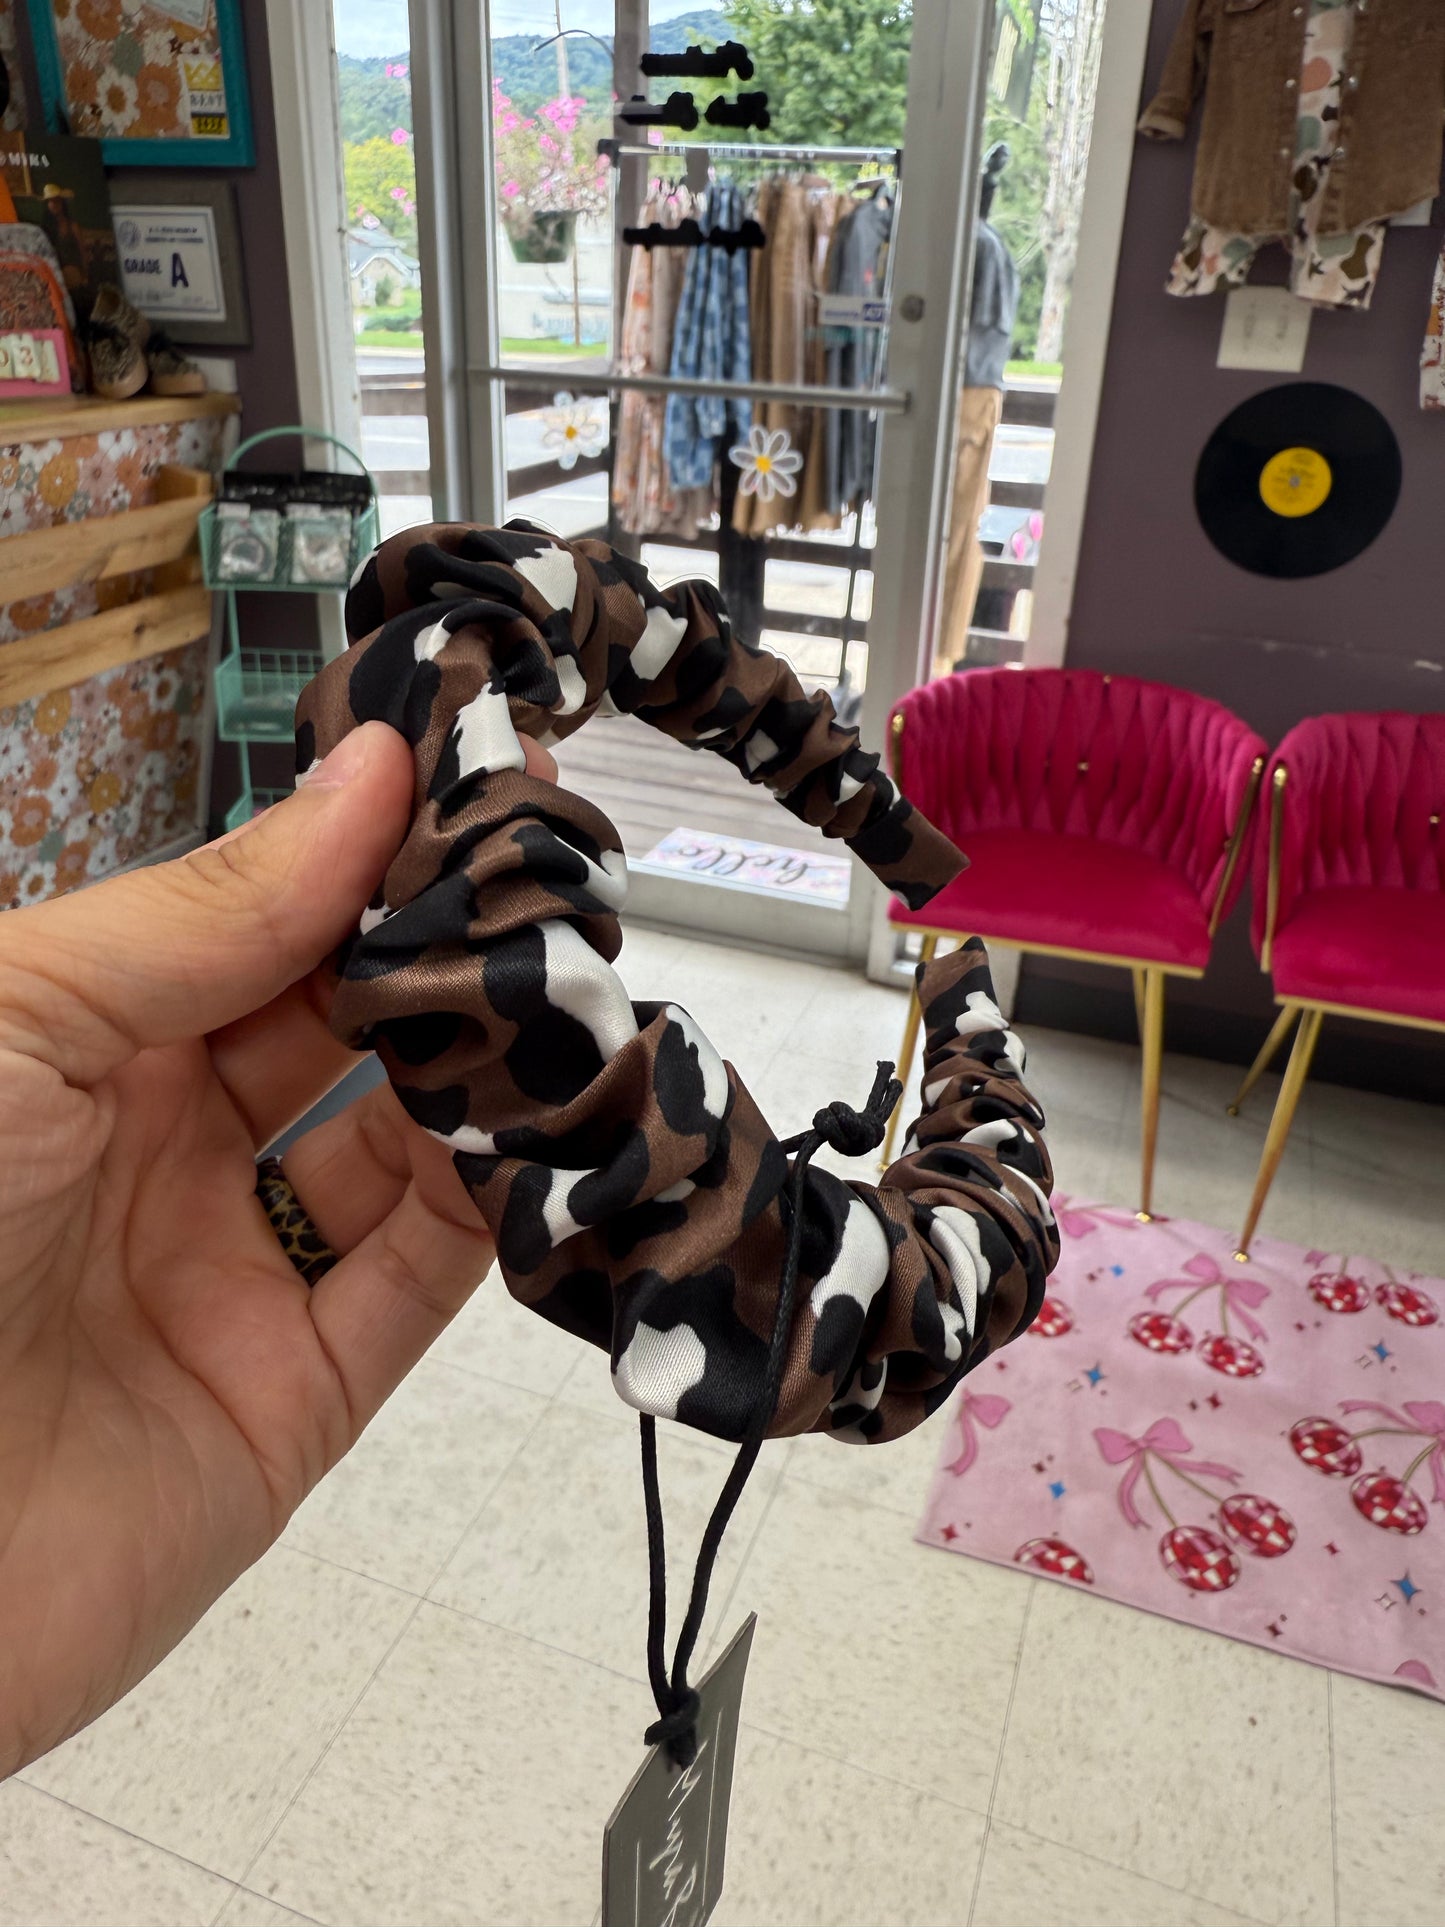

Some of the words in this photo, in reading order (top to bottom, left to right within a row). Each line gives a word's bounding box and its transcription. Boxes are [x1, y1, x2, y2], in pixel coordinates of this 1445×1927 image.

[124, 257, 162, 275] GRADE
[171, 252, 189, 288] A
[678, 844, 813, 885] hello
